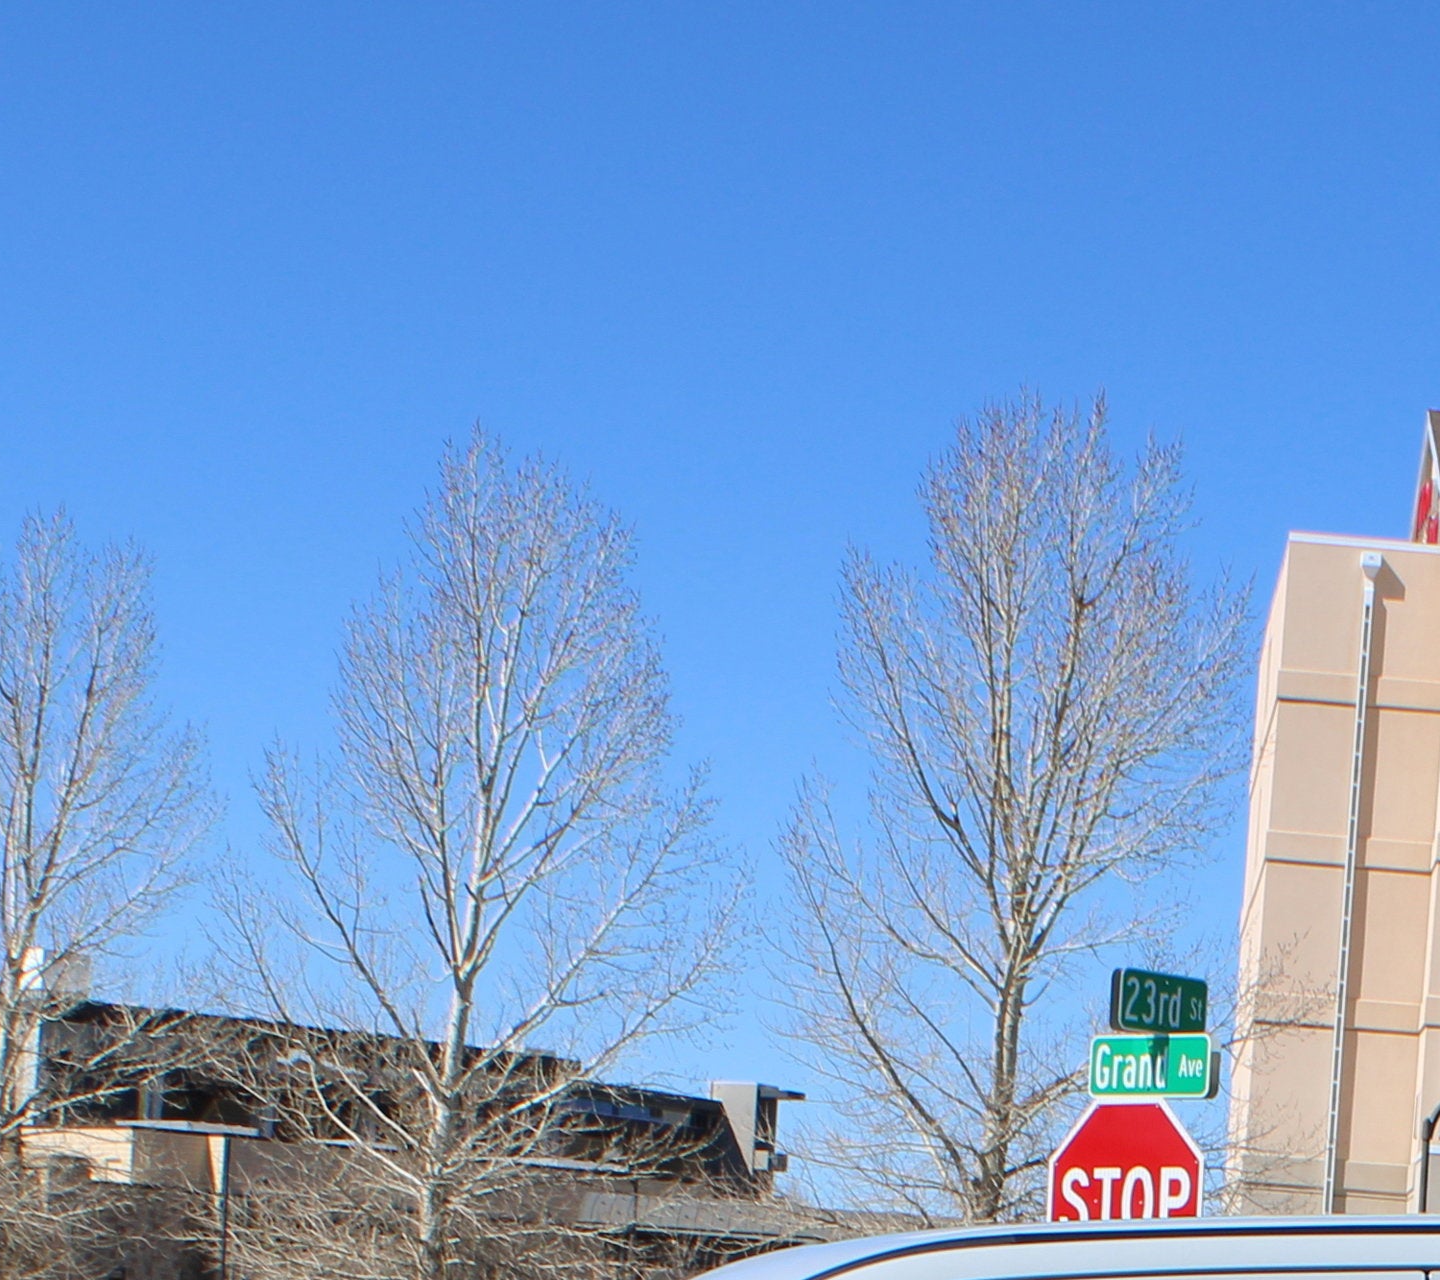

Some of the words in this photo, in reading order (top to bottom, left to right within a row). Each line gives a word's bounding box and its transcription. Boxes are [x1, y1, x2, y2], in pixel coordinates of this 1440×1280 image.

[1123, 975, 1181, 1029] 23rd
[1189, 995, 1204, 1020] St
[1095, 1043, 1167, 1090] Grand
[1178, 1055, 1204, 1079] Ave
[1060, 1165, 1191, 1222] STOP
